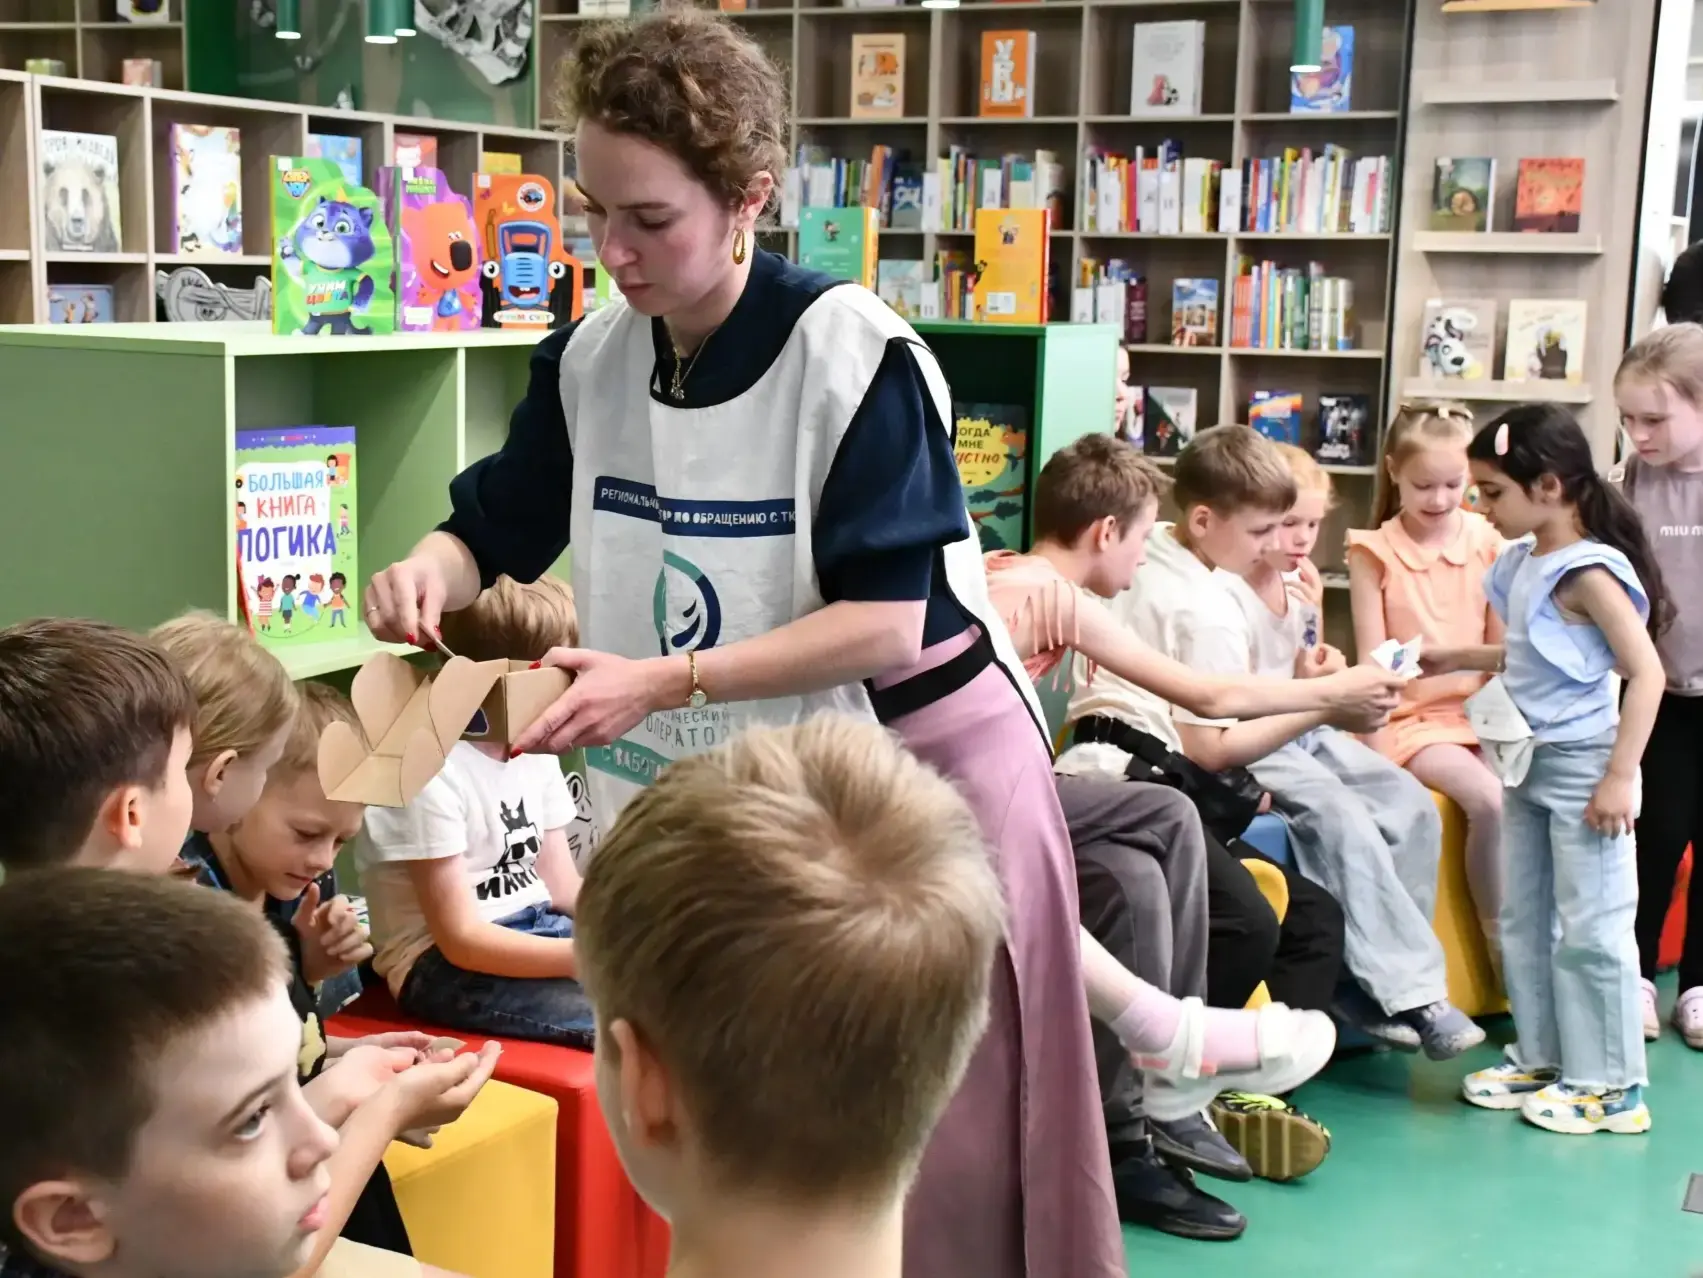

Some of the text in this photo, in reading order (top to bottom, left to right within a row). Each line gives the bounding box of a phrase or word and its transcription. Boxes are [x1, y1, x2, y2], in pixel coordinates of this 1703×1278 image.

[957, 426, 991, 438] ОГДА
[958, 439, 985, 449] МНЕ
[248, 469, 325, 493] БОЛЬШАЯ
[256, 494, 317, 519] КНИГА
[692, 512, 768, 527] ОБРАЩЕНИЮ
[769, 511, 778, 523] С
[645, 714, 730, 748] ОПЕРАТОР
